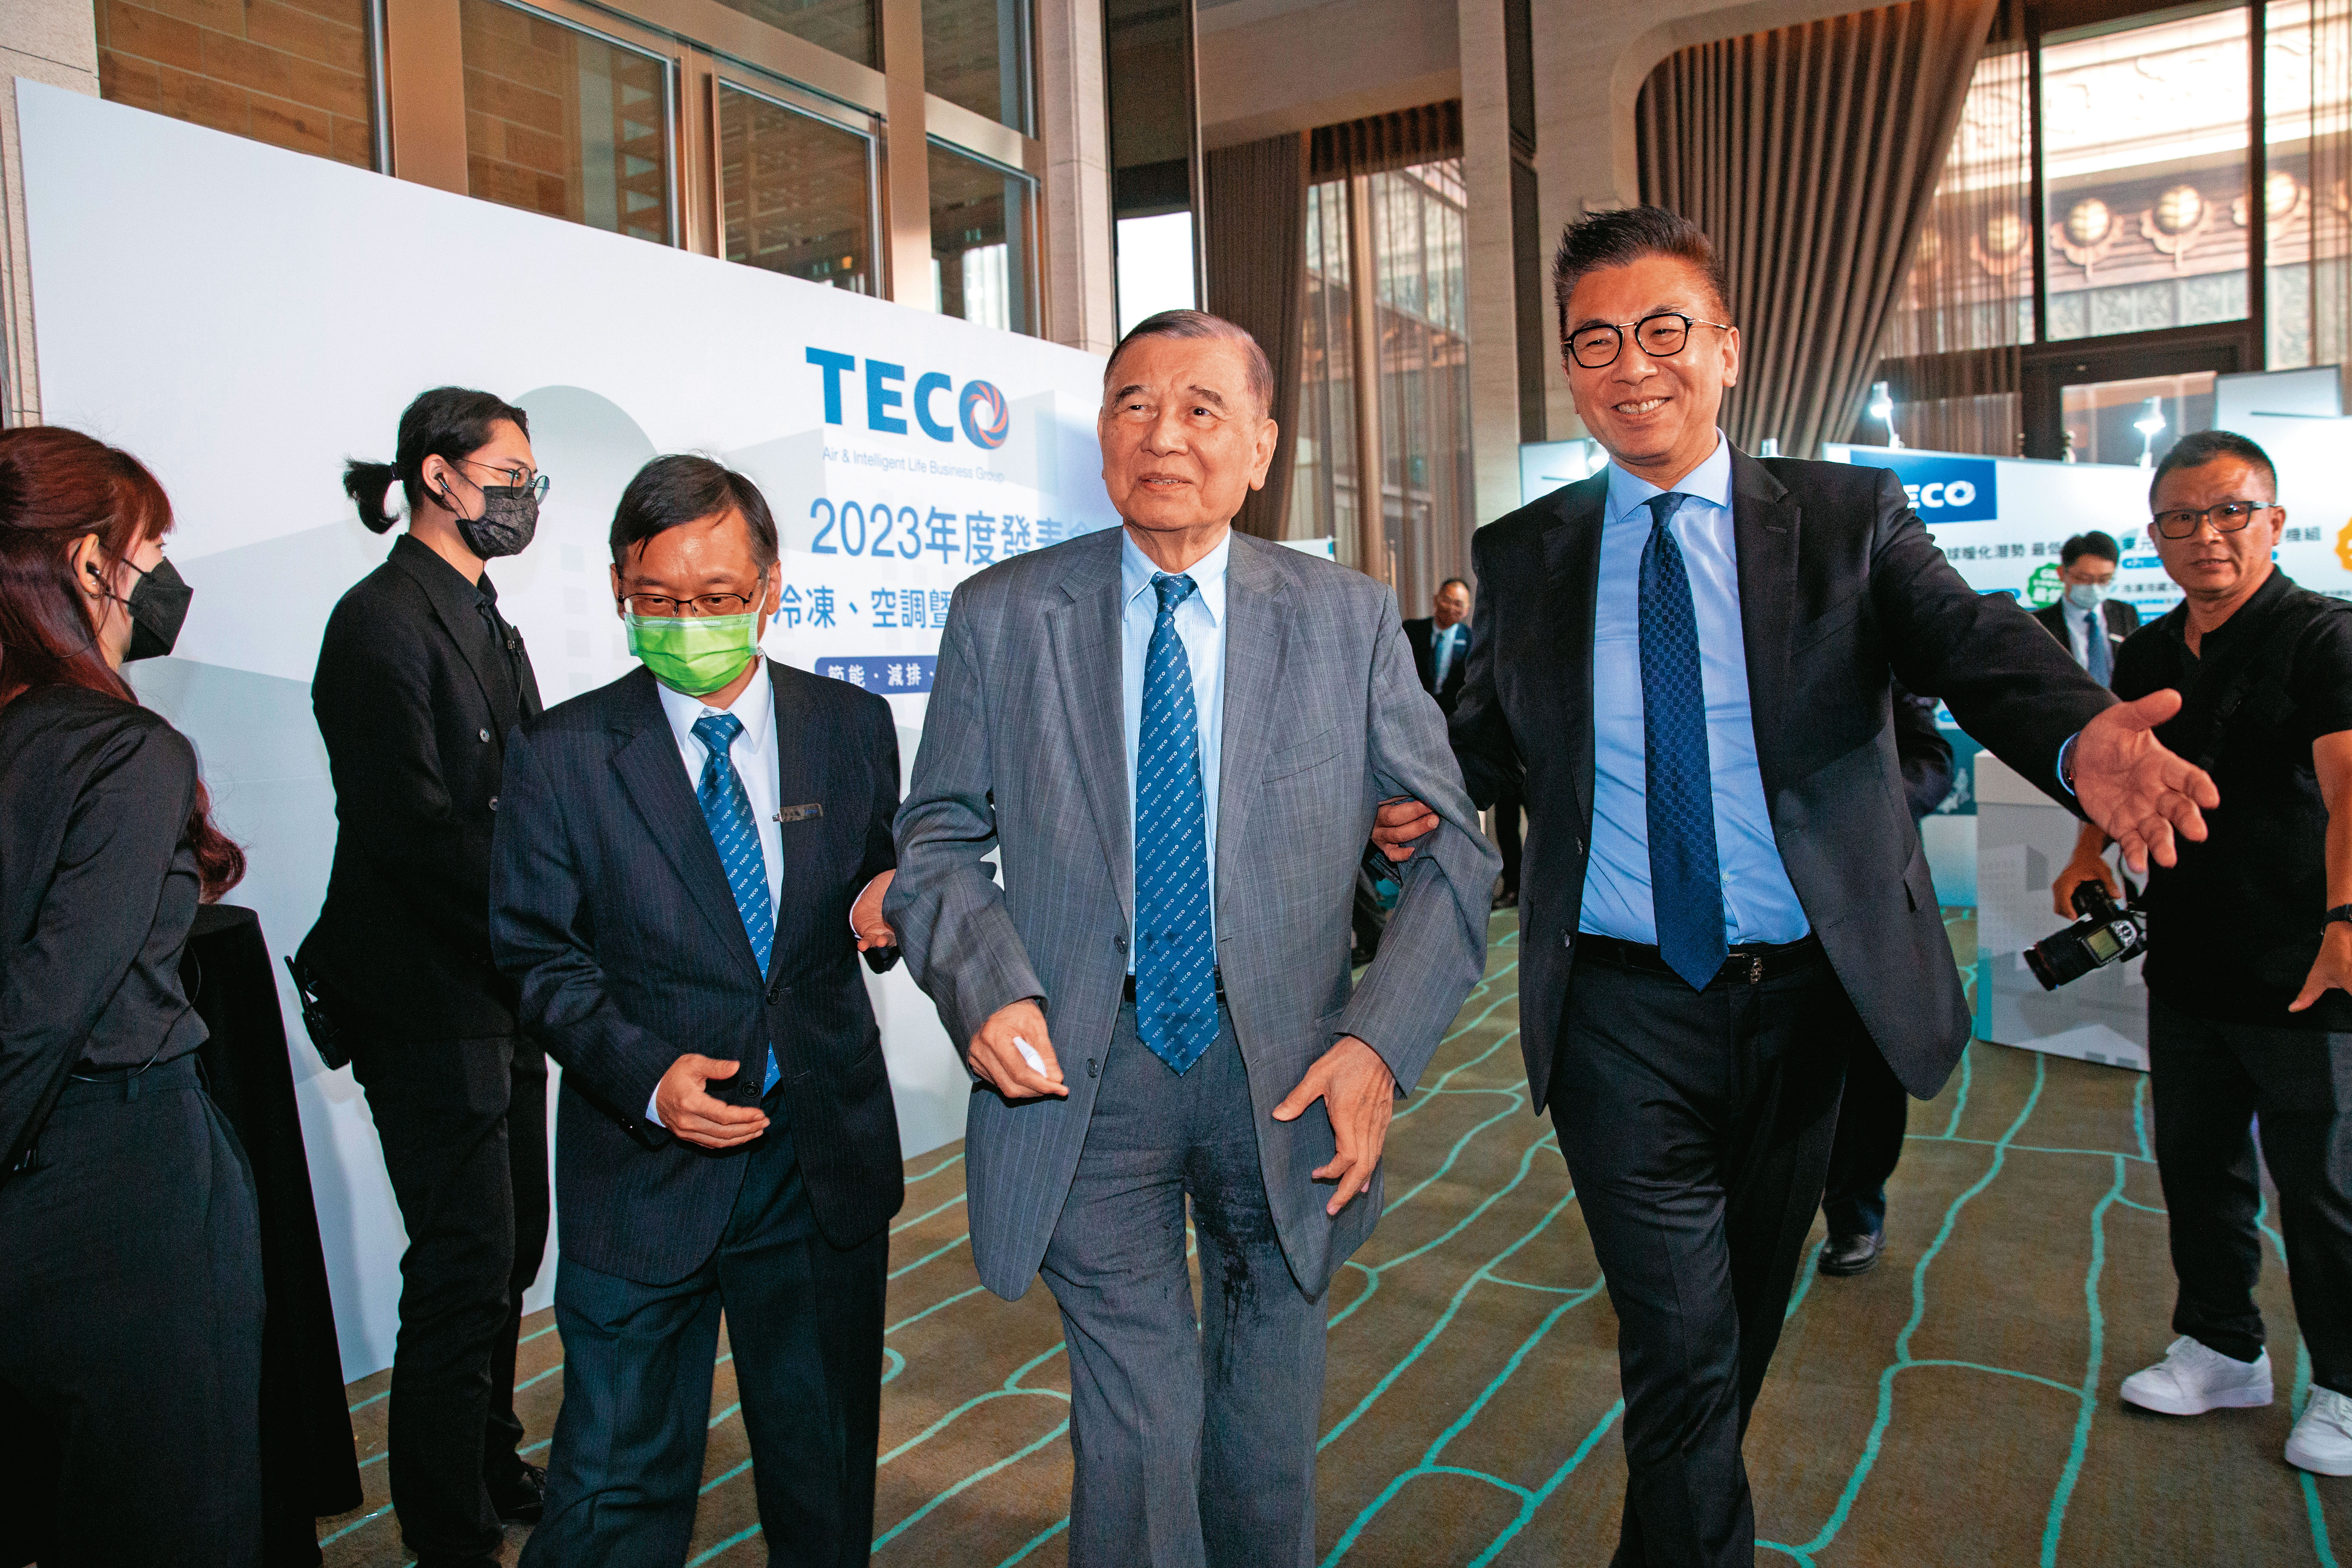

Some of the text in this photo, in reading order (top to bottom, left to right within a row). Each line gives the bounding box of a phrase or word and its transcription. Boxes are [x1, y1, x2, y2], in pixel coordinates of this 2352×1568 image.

[806, 346, 1009, 450] TECO
[823, 446, 1004, 482] Air & Intelligent Life Business Group
[1903, 480, 1976, 509] ECO
[1162, 617, 1172, 628] TECO
[1159, 643, 1170, 655] TECO
[1148, 659, 1157, 672] TECO
[1167, 655, 1178, 668] TECO
[1155, 671, 1166, 684] TECO
[1176, 669, 1185, 681] TECO
[1144, 687, 1153, 699] TECO
[1164, 683, 1175, 696] TECO
[1151, 699, 1162, 712] TECO
[1173, 696, 1184, 709] TECO
[1160, 711, 1171, 724] TECO
[1182, 708, 1193, 720] TECO
[1148, 727, 1158, 740] TECO
[1170, 723, 1181, 736] TECO
[1156, 739, 1168, 752] TECO
[1179, 735, 1190, 748] TECO
[1166, 751, 1178, 763] TECO
[1189, 747, 1198, 760] TECO
[1144, 754, 1155, 767] TECO
[1153, 766, 1165, 779] TECO
[1176, 762, 1188, 775] TECO
[1163, 778, 1175, 791] TECO
[1186, 774, 1196, 787] TECO
[1140, 782, 1152, 795] TECO
[1150, 794, 1162, 806] TECO
[1173, 790, 1184, 802] TECO
[712, 799, 722, 811] TECO
[1183, 802, 1194, 814] TECO
[721, 809, 732, 821] TECO
[1138, 809, 1149, 822] TECO
[1160, 805, 1171, 818] TECO
[1170, 817, 1182, 830] TECO
[1193, 813, 1204, 825] TECO
[710, 824, 720, 835] TECO
[730, 819, 740, 832] TECO
[1148, 821, 1159, 833] TECO
[719, 834, 730, 846] TECO
[1157, 833, 1169, 845] TECO
[1180, 828, 1192, 841] TECO
[1136, 837, 1146, 849] TECO
[1191, 840, 1202, 853] TECO
[729, 844, 739, 856] TECO
[1145, 848, 1156, 861] TECO
[1168, 844, 1179, 857] TECO
[739, 853, 749, 866] TECO
[1179, 856, 1190, 868] TECO
[749, 863, 760, 876] TECO
[1155, 860, 1166, 872] TECO
[727, 868, 738, 880] TECO
[1166, 871, 1177, 884] TECO
[1189, 867, 1200, 879] TECO
[737, 878, 748, 890] TECO
[1142, 876, 1153, 887] TECO
[748, 887, 759, 900] TECO
[1153, 887, 1164, 899] TECO
[1176, 882, 1188, 895] TECO
[758, 897, 769, 909] TECO
[1163, 898, 1175, 910] TECO
[1187, 893, 1199, 906] TECO
[738, 902, 747, 913] ECO
[1140, 902, 1151, 914] TECO
[1198, 904, 1209, 917] TECO
[746, 912, 758, 924] TECO
[1151, 913, 1162, 925] TECO
[1174, 909, 1185, 921] TECO
[757, 921, 768, 933] TECO
[1161, 924, 1172, 936] TECO
[1185, 920, 1196, 932] TECO
[1137, 929, 1148, 941] TECO
[1172, 935, 1183, 946] TECO
[1196, 930, 1207, 943] TECO
[1148, 940, 1159, 951] TECO
[756, 946, 767, 958] TECO
[1159, 950, 1170, 962] TECO
[1182, 946, 1194, 958] TECO
[1136, 955, 1146, 966] TECO
[1169, 961, 1180, 972] TECO
[1193, 956, 1205, 969] TECO
[1145, 965, 1156, 977] TECO
[1156, 976, 1168, 988] TECO
[1179, 972, 1191, 983] TECO
[1167, 987, 1178, 998] TECO
[1191, 982, 1203, 994] TECO
[1143, 991, 1154, 1003] TECO
[1178, 997, 1189, 1009] TECO
[1202, 992, 1214, 1005] TECO
[1154, 1002, 1165, 1013] TECO
[1190, 1008, 1201, 1019] TECO
[1141, 1017, 1152, 1028] TECO
[1165, 1012, 1176, 1024] TECO
[1200, 1018, 1212, 1030] TECO
[1152, 1027, 1163, 1038] TECO
[1177, 1023, 1187, 1034] TECO
[1164, 1037, 1175, 1048] TECO
[1188, 1033, 1199, 1045] TECO
[1175, 1048, 1186, 1059] TECO
[1199, 1043, 1210, 1054] TECO
[1186, 1058, 1197, 1069] TECO
